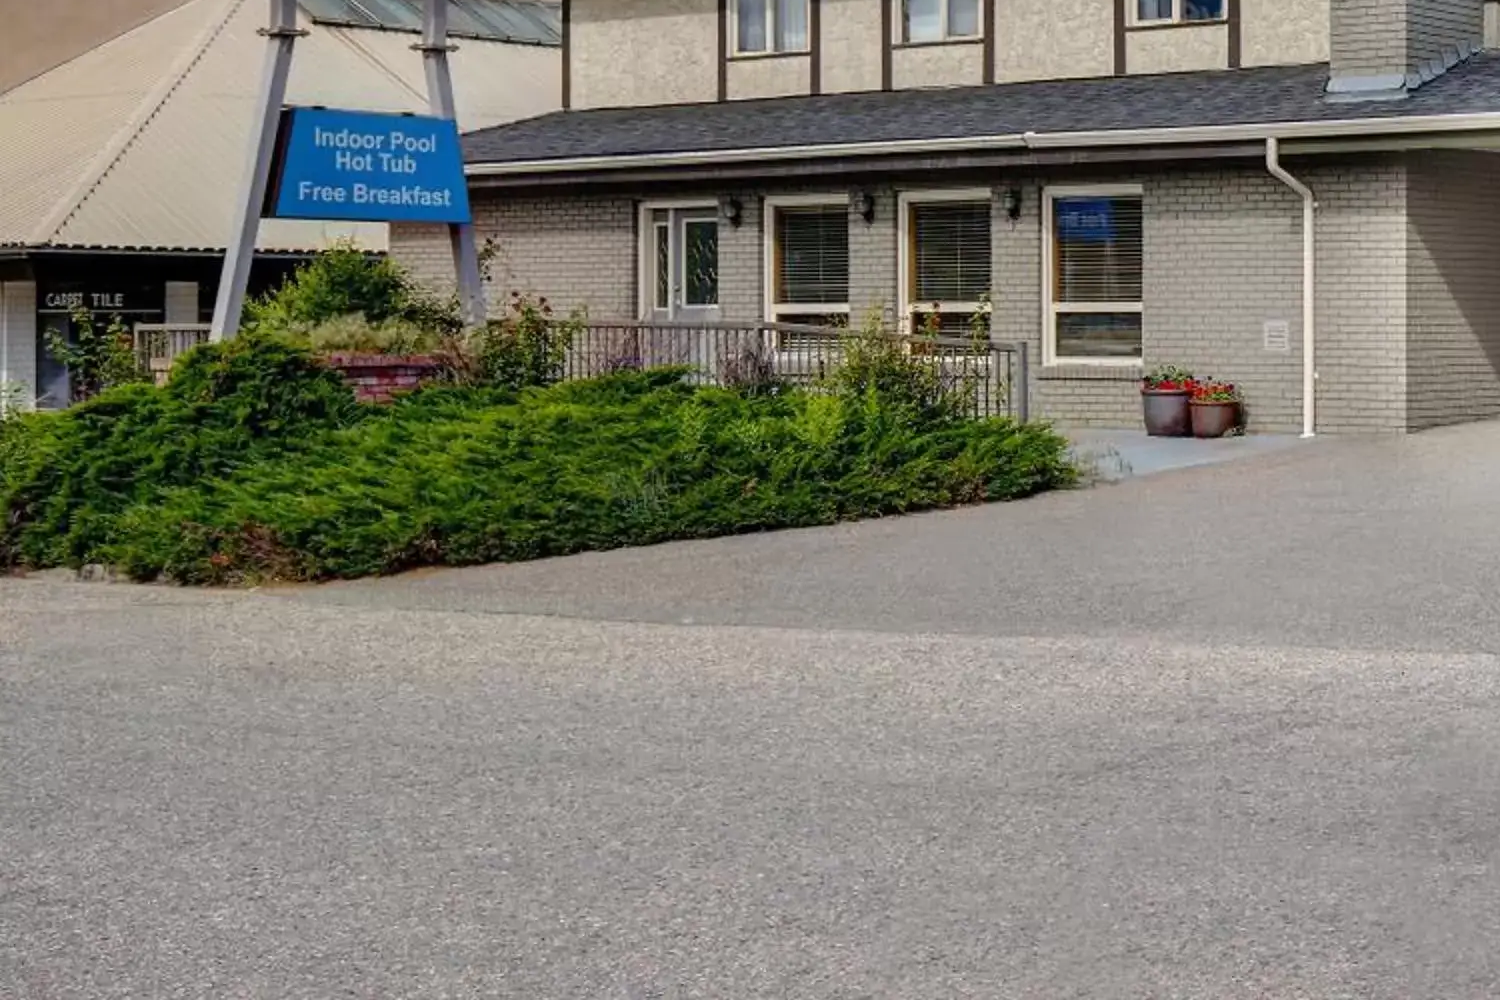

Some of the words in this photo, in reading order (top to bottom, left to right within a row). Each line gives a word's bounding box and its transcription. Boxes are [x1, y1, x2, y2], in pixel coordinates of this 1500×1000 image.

[314, 126, 384, 150] Indoor
[390, 131, 437, 153] Pool
[335, 151, 373, 172] Hot
[378, 153, 417, 174] Tub
[298, 181, 347, 202] Free
[353, 183, 453, 206] Breakfast
[91, 293, 125, 307] TILE
